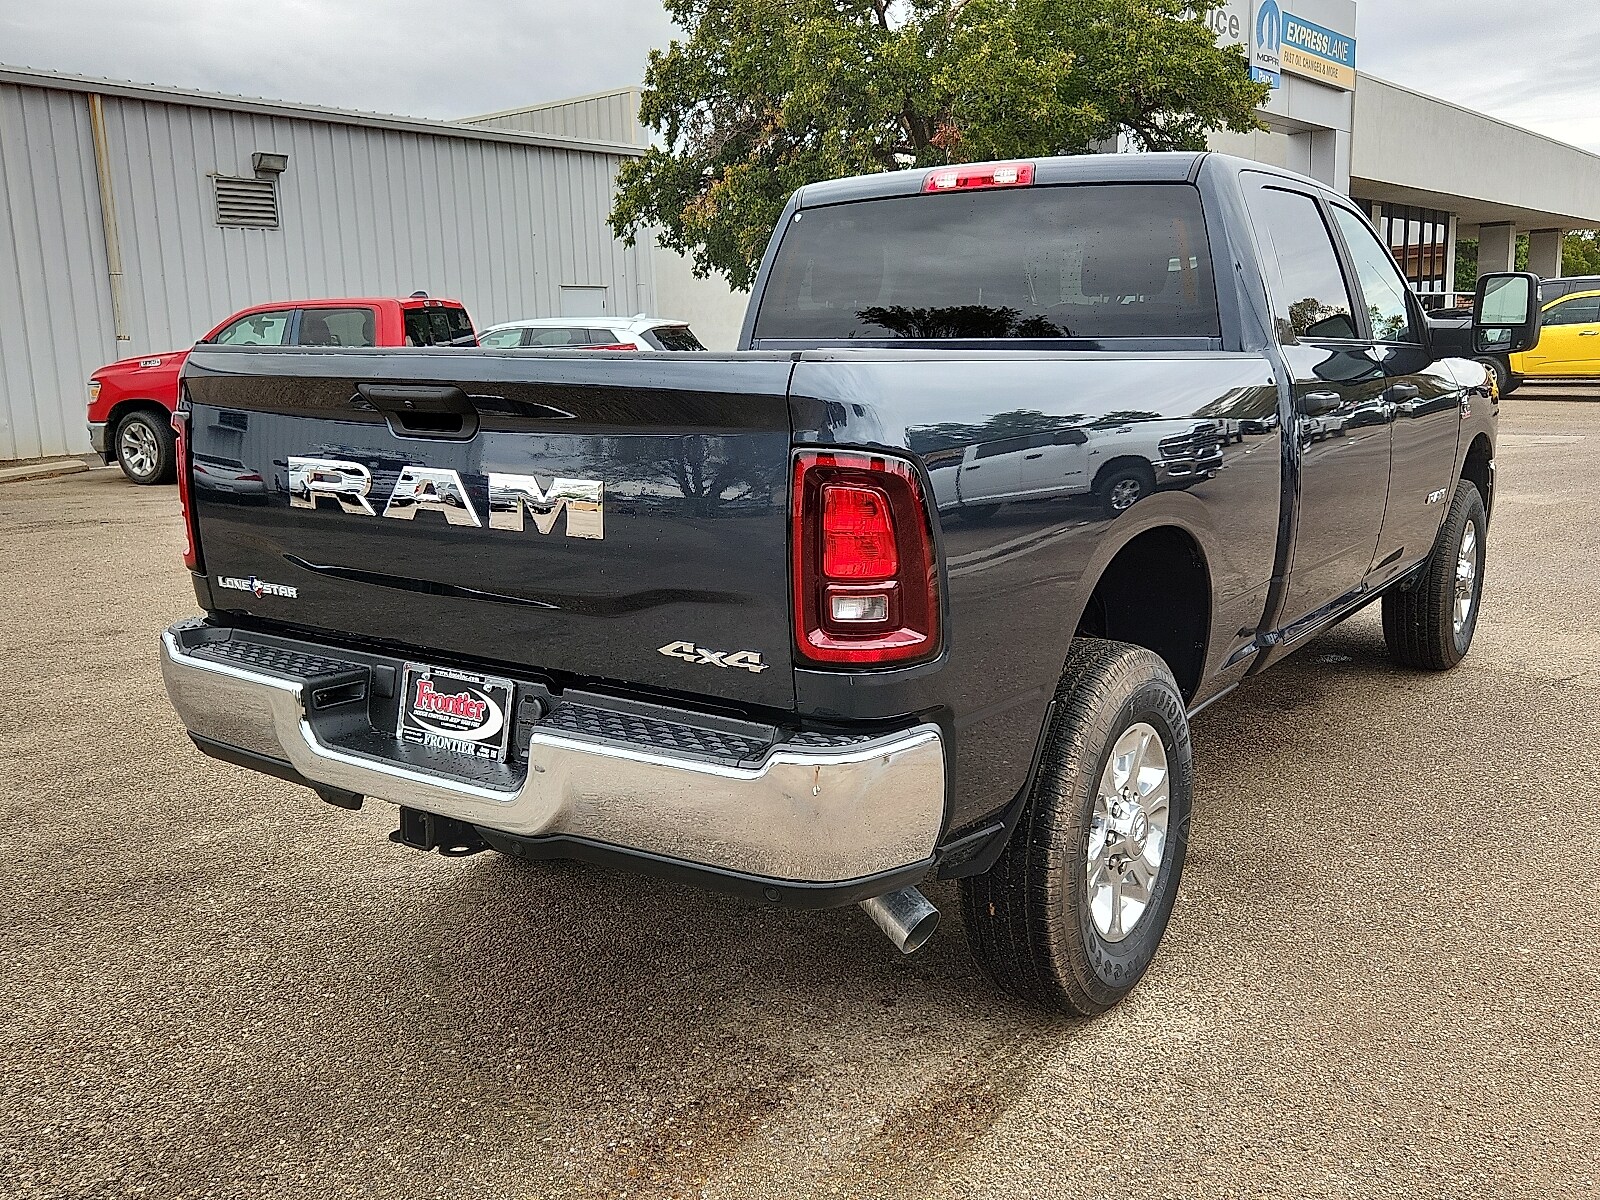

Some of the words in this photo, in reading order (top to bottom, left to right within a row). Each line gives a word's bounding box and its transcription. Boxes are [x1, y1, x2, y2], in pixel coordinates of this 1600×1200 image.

[1256, 53, 1280, 67] MOPAR
[1283, 50, 1294, 64] FAST
[1302, 57, 1322, 73] CHANGES
[1326, 65, 1339, 78] MORE
[288, 456, 604, 540] RAM
[217, 575, 251, 591] LONE
[262, 582, 299, 599] STAR
[657, 640, 770, 674] 4x4
[415, 680, 486, 721] Frontier
[423, 732, 476, 756] FRONTIER
